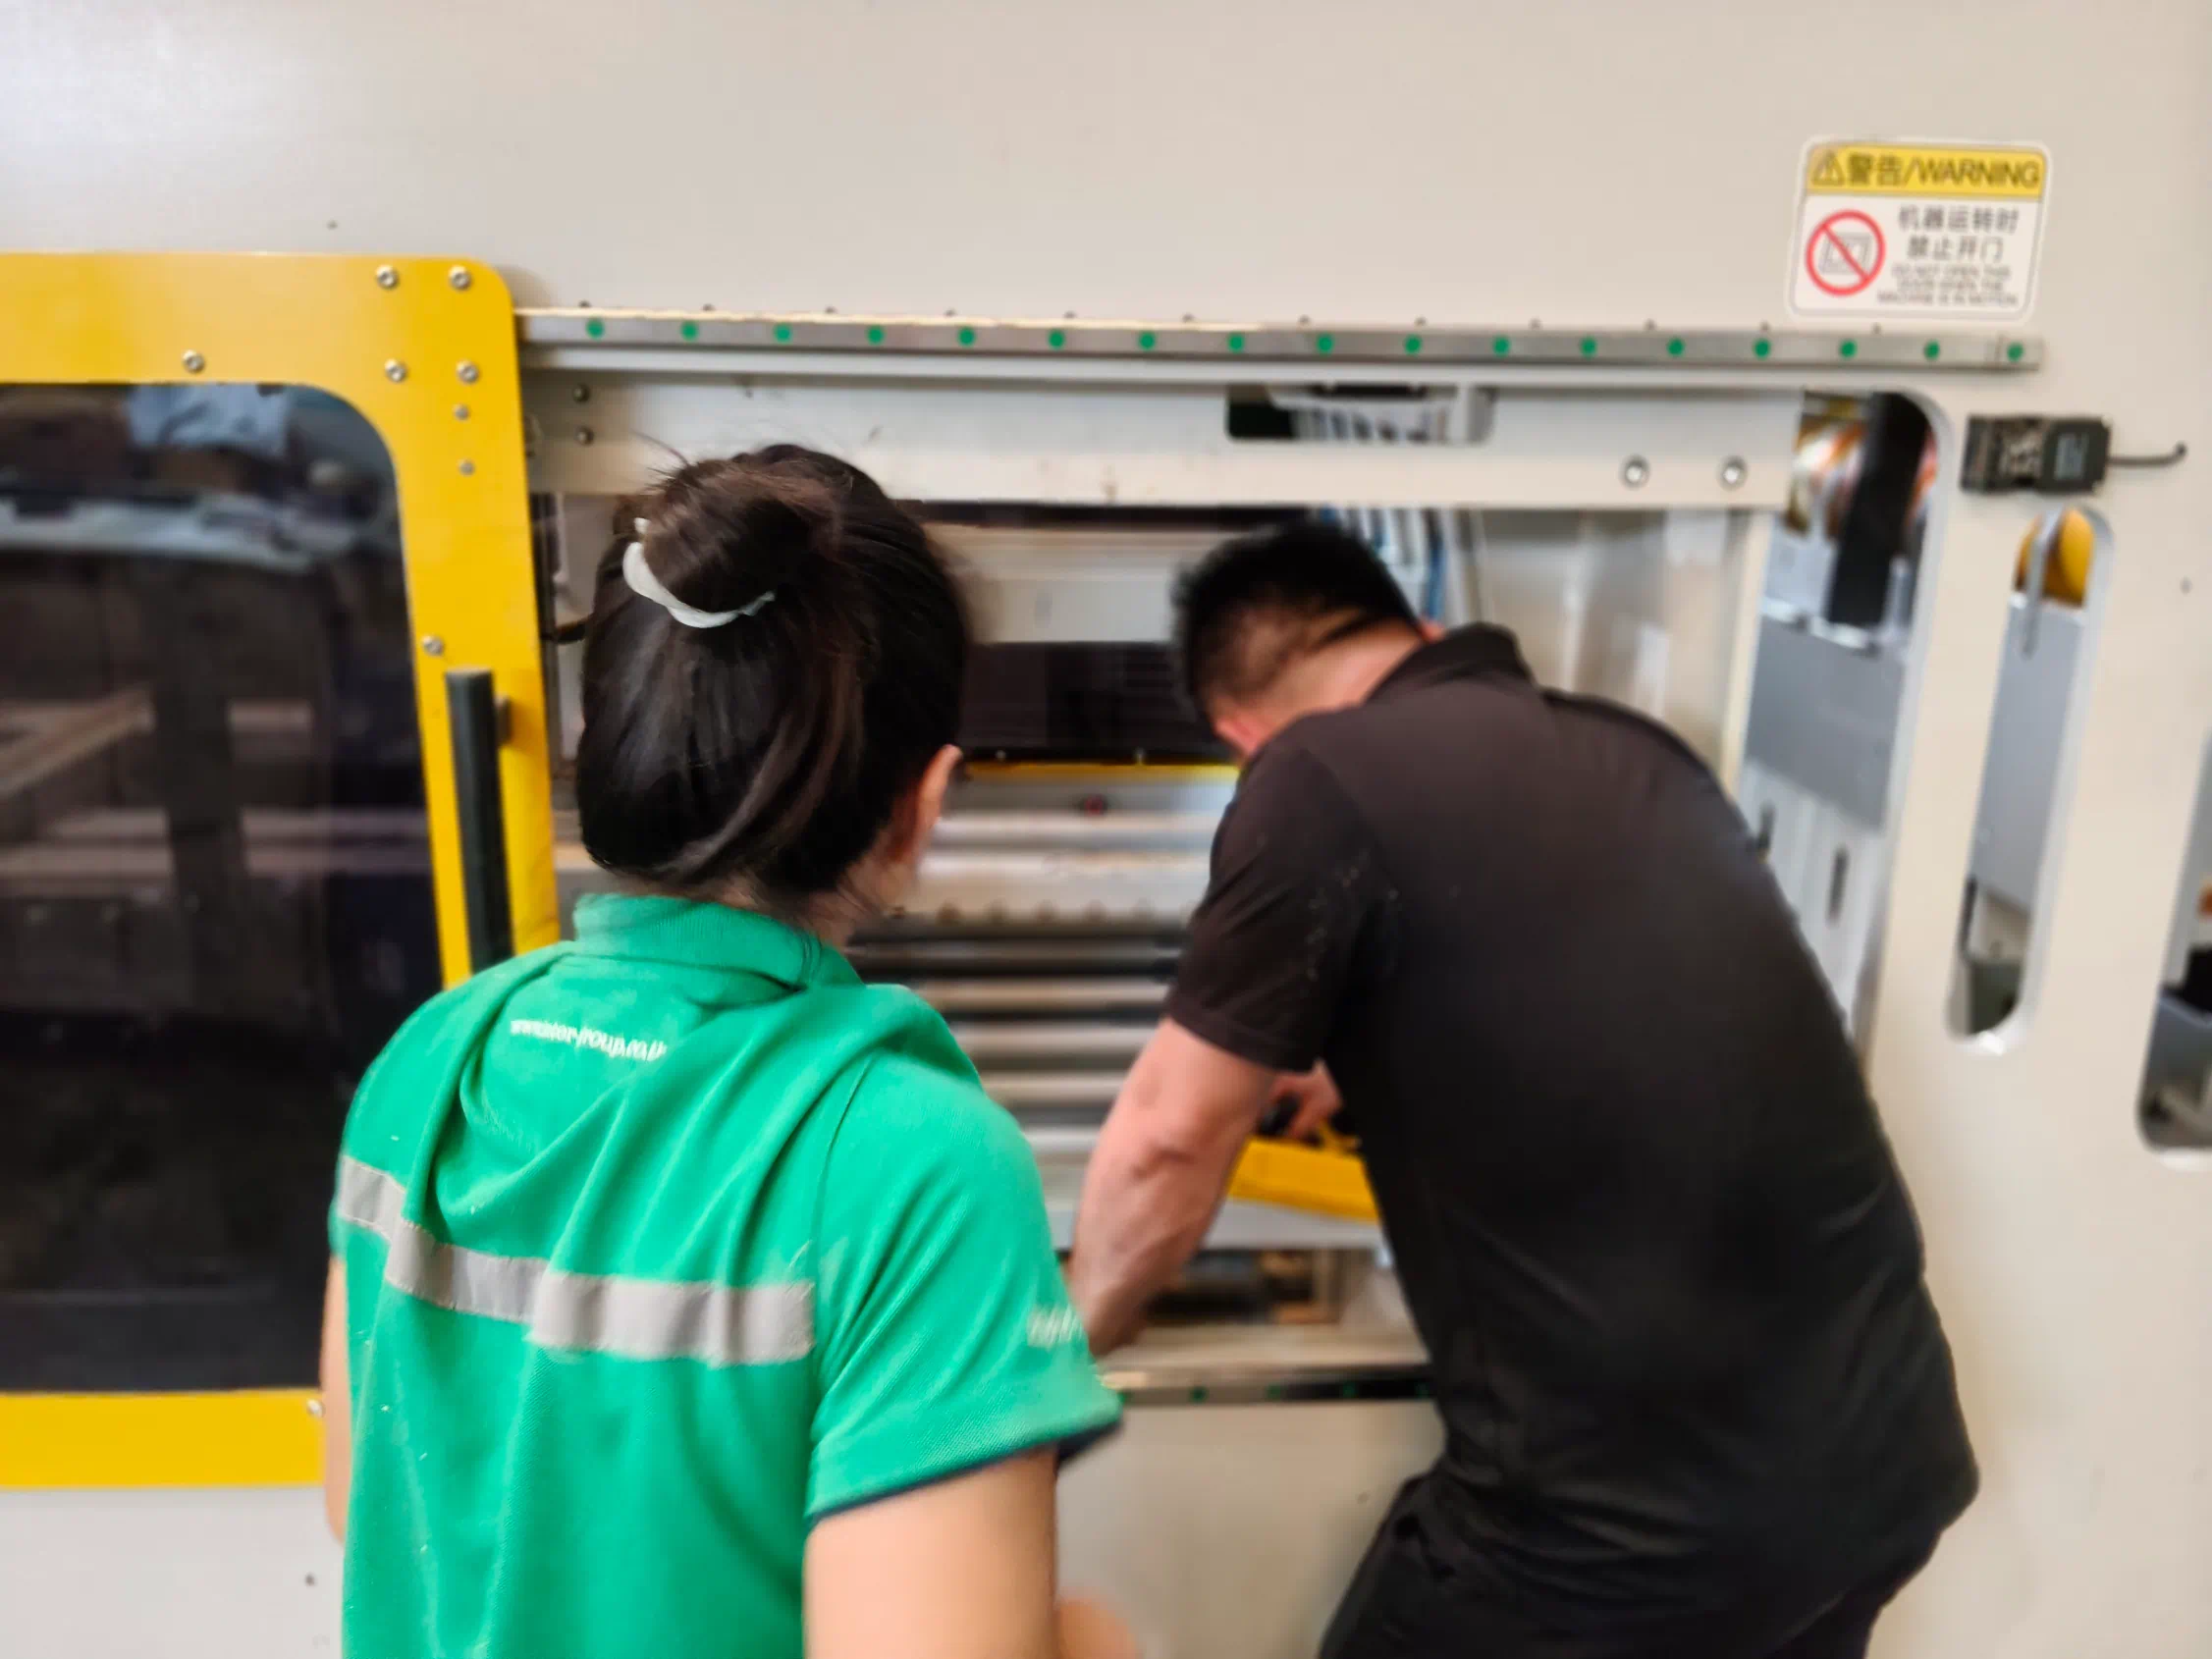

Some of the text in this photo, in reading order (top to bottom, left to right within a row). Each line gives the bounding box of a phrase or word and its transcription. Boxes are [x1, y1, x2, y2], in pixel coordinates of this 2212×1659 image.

[1848, 151, 2040, 188] 警告/WARNING
[1898, 204, 2019, 235] 机器运转时
[1907, 235, 2004, 262] 禁止开门
